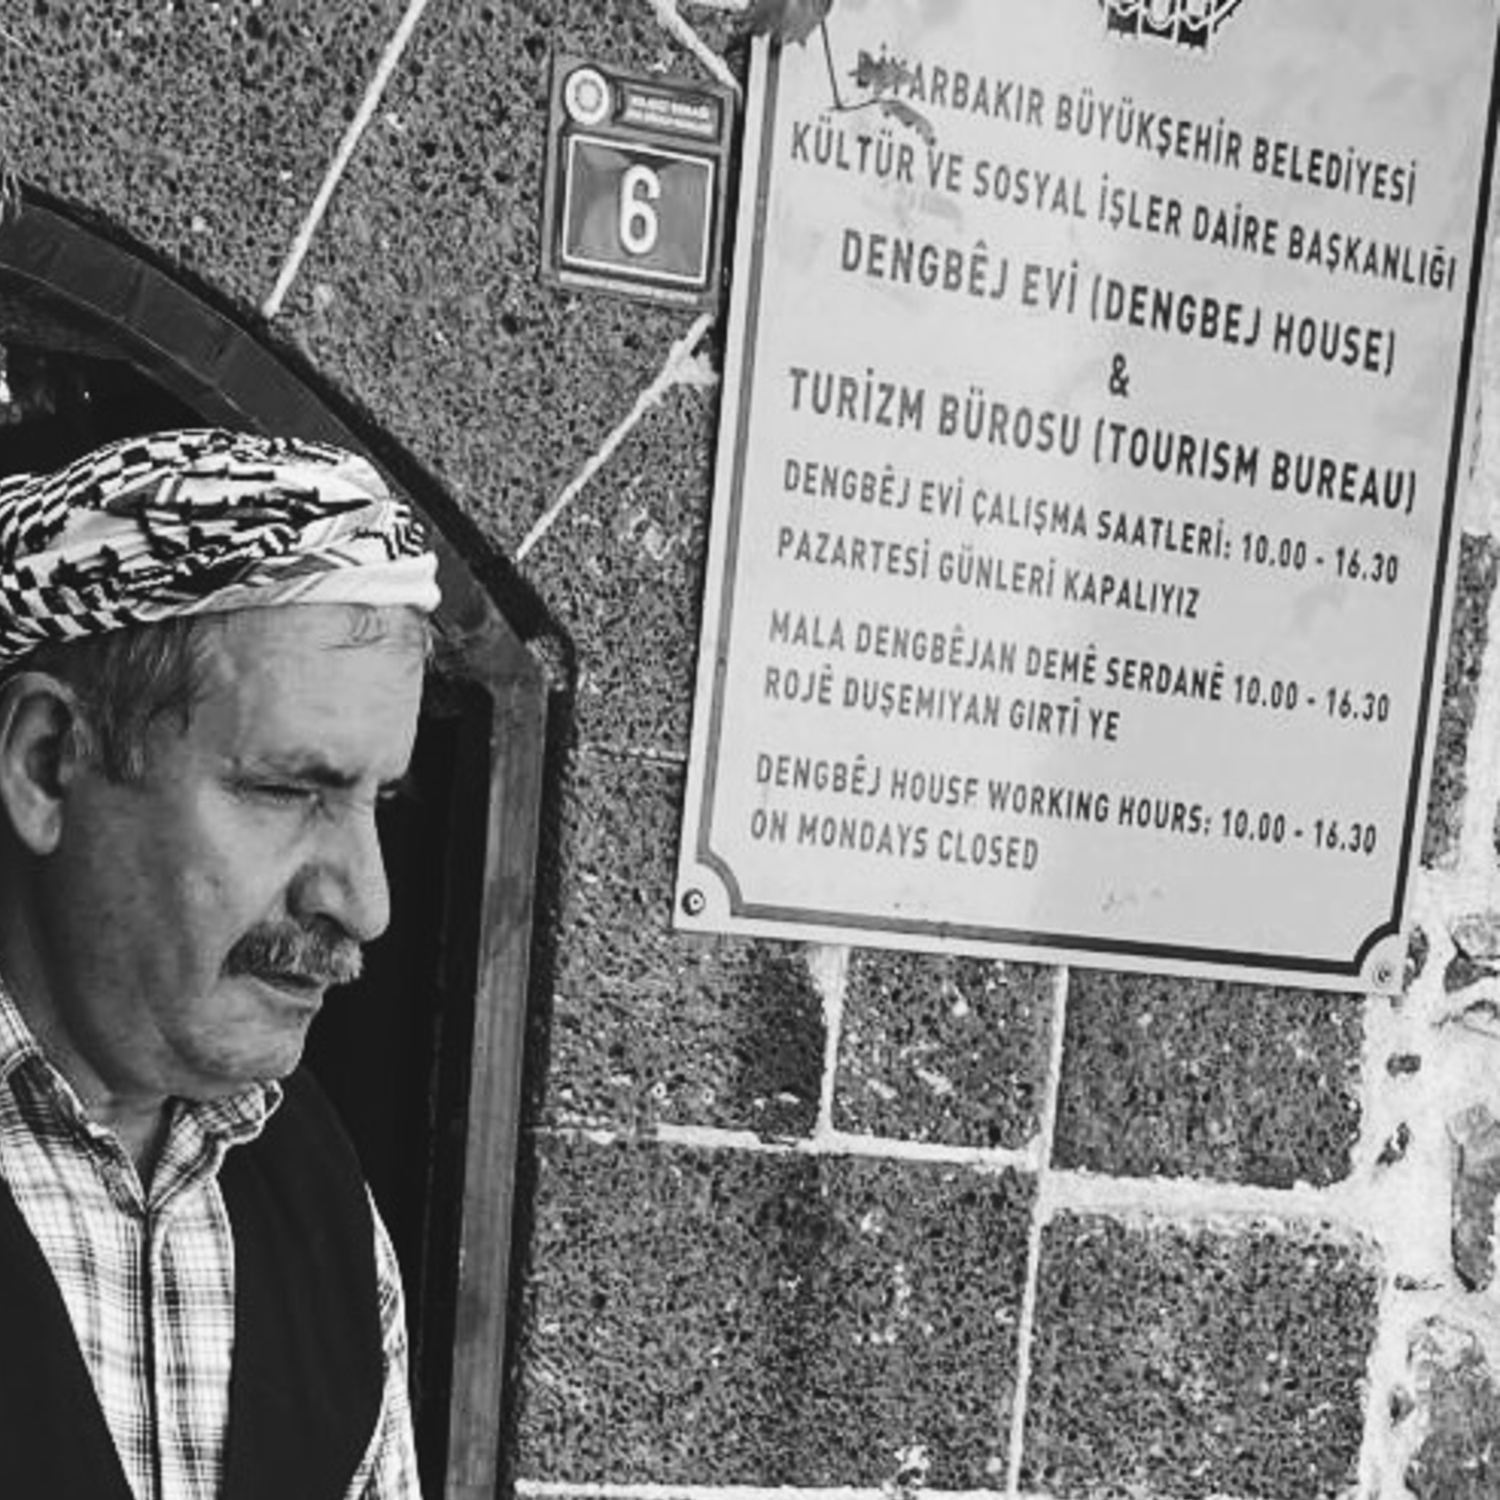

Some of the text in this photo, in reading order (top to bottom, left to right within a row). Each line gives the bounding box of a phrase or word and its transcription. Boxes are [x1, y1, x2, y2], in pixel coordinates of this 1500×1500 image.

[1056, 87, 1243, 169] BÜYÜKŞEHİR
[1252, 136, 1417, 206] BELEDİYESİ
[619, 163, 661, 254] 6
[791, 114, 1457, 292] KÜLTÜR VE SOSYAL İŞLER DAİRE BAŞKANLIĞI
[840, 228, 1008, 300] DENGBÊJ
[1020, 258, 1079, 315] EVİ
[1090, 273, 1261, 347] (DENGBEJ
[789, 366, 926, 432] TURİZM
[938, 384, 1082, 456] BÜROSU
[1093, 417, 1259, 488] (TOURISM
[1108, 352, 1131, 398] &
[777, 525, 1201, 620] PAZARTESİ GÜNLERİ KAPALIYIZ
[783, 458, 912, 510] DENGBÊJ
[919, 476, 964, 518] EVİ
[971, 488, 1088, 538] ÇALIŞMA
[1096, 509, 1231, 561] SAATLERİ:
[1242, 531, 1307, 571] 10.00
[1335, 546, 1399, 585] 16.30
[764, 662, 834, 707] ROJÊ
[1088, 706, 1121, 742] YE
[768, 608, 846, 651] MALA
[853, 621, 1018, 675] DENGBÊJAN
[1024, 642, 1098, 686] DEMÊ
[1103, 655, 1225, 702] SERDANÊ
[1233, 673, 1298, 711] 10.00
[1325, 686, 1390, 724] 16.30
[749, 807, 1040, 871] ON MONDAYS CLOSED
[755, 751, 881, 797] DENGBÊJ
[987, 777, 1111, 824] WORKING
[1117, 794, 1213, 837] HOURS:
[1221, 806, 1287, 844] 10.00
[1313, 818, 1378, 856] 16.30
